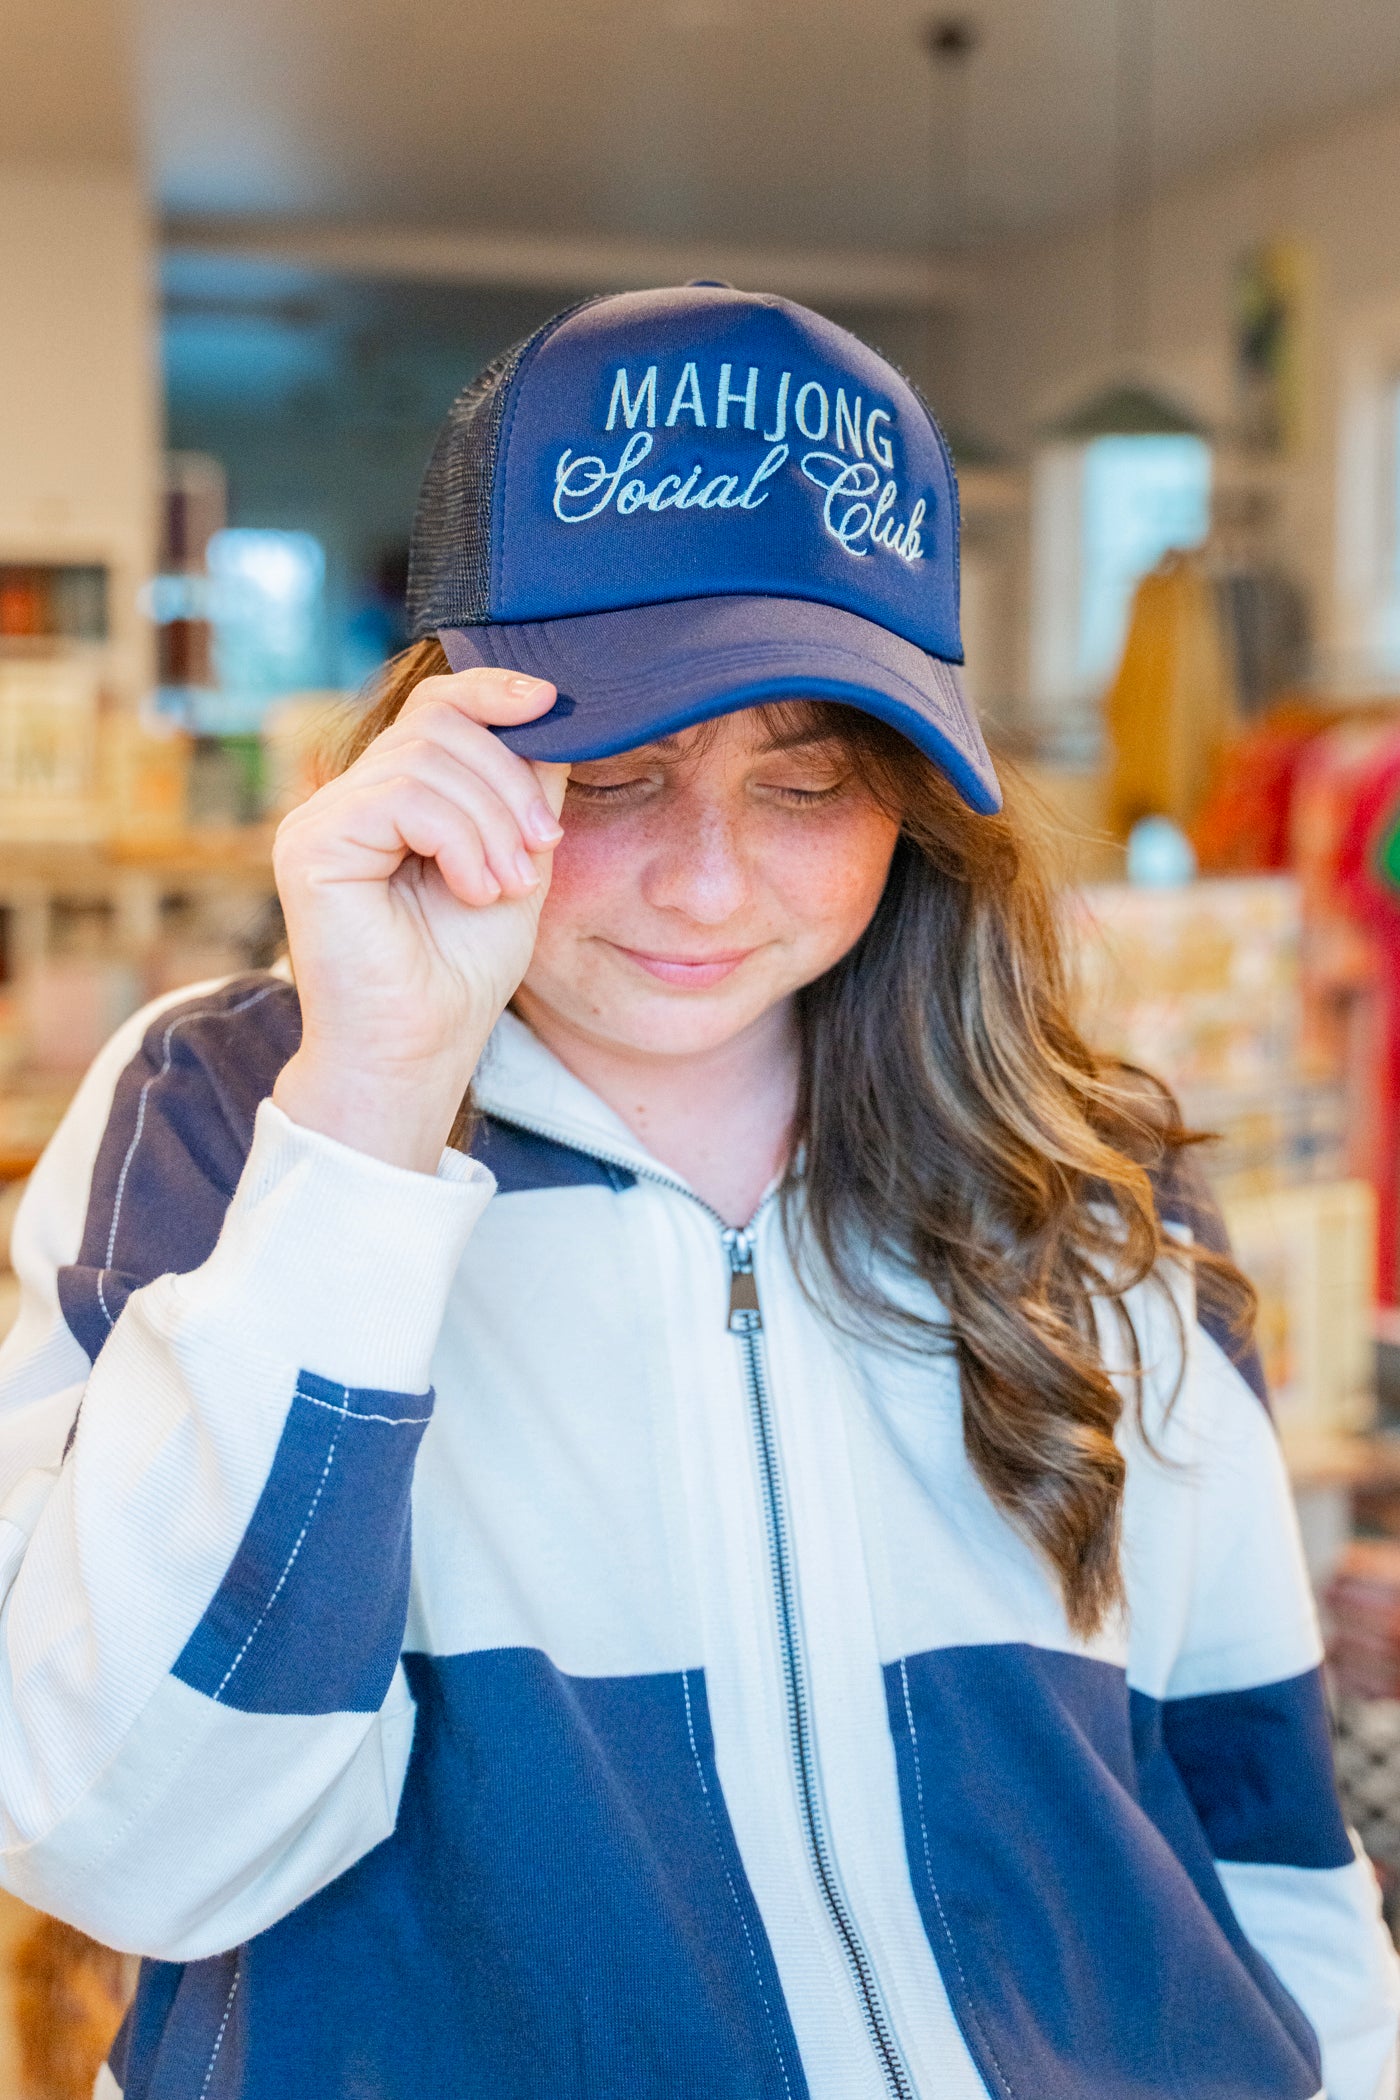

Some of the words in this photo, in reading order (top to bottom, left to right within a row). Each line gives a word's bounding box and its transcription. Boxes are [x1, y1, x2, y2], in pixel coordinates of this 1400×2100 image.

[605, 363, 894, 468] MAHJONG
[553, 431, 788, 522] Social
[801, 452, 926, 561] Club
